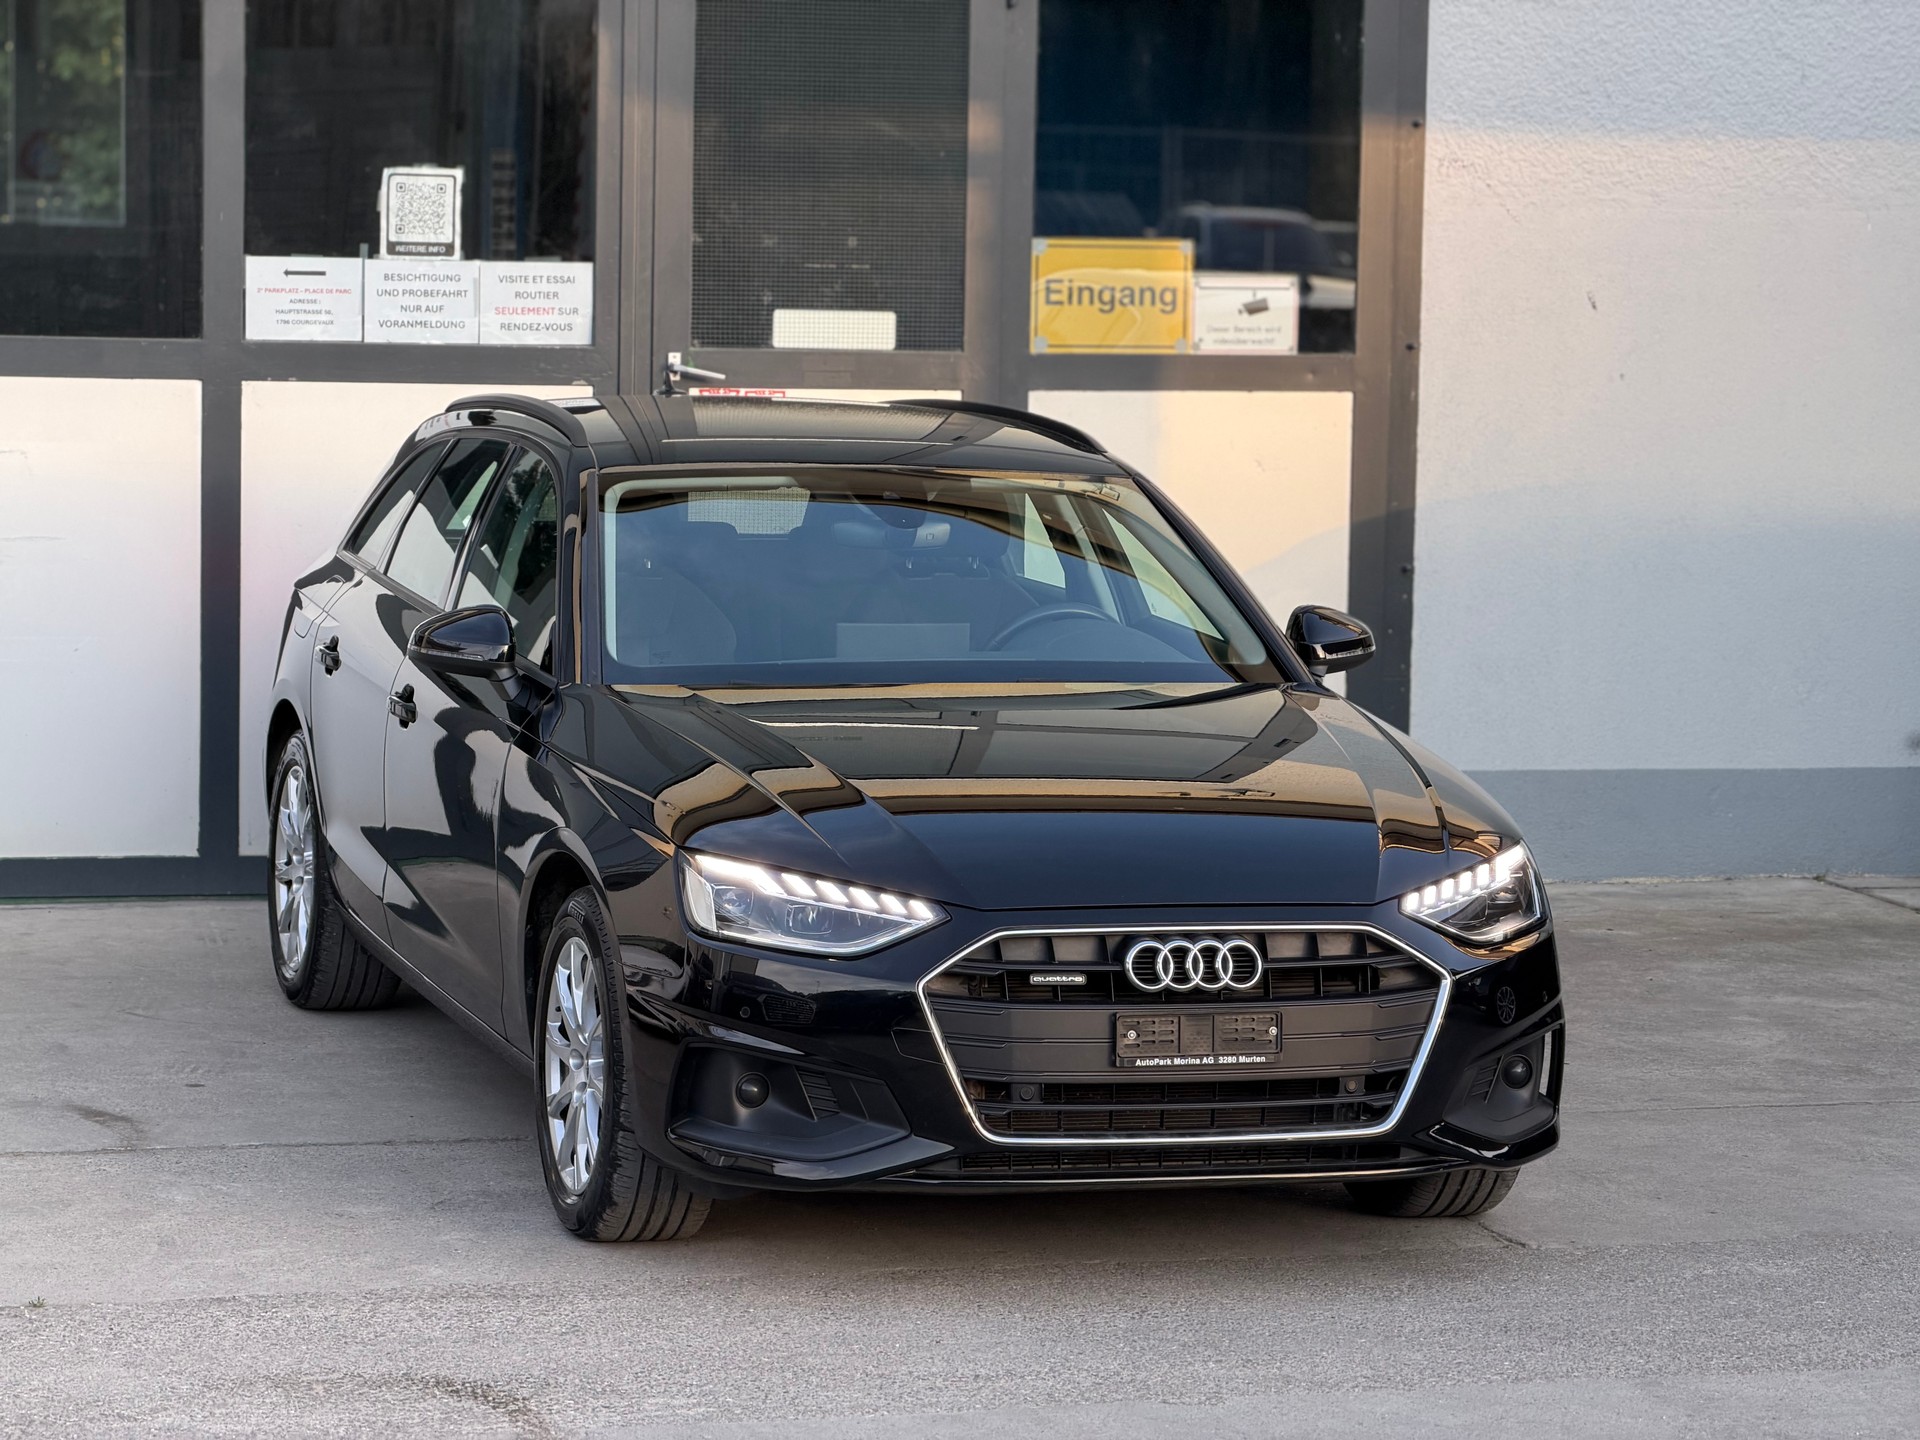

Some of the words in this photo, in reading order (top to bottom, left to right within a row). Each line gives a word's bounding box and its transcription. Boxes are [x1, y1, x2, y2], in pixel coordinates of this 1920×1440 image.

[383, 273, 462, 283] BESICHTIGUNG
[498, 275, 530, 284] VISITE
[532, 275, 544, 284] ET
[546, 275, 576, 285] ESSAI
[376, 289, 400, 298] UND
[402, 289, 468, 299] PROBEFAHRT
[515, 291, 560, 300] ROUTIER
[1044, 279, 1178, 314] Eingang
[400, 305, 422, 314] NUR
[424, 305, 445, 314] AUF
[494, 306, 556, 316] SEULEMENT
[557, 307, 579, 316] SUR
[379, 320, 466, 330] VORANMELDUNG
[500, 322, 574, 332] RENDEZ-VOUS
[1033, 975, 1083, 983] quattro
[1135, 1058, 1172, 1066] AutoPark
[1174, 1057, 1200, 1065] Morina
[1202, 1056, 1214, 1064] AG
[1238, 1055, 1266, 1063] Murten
